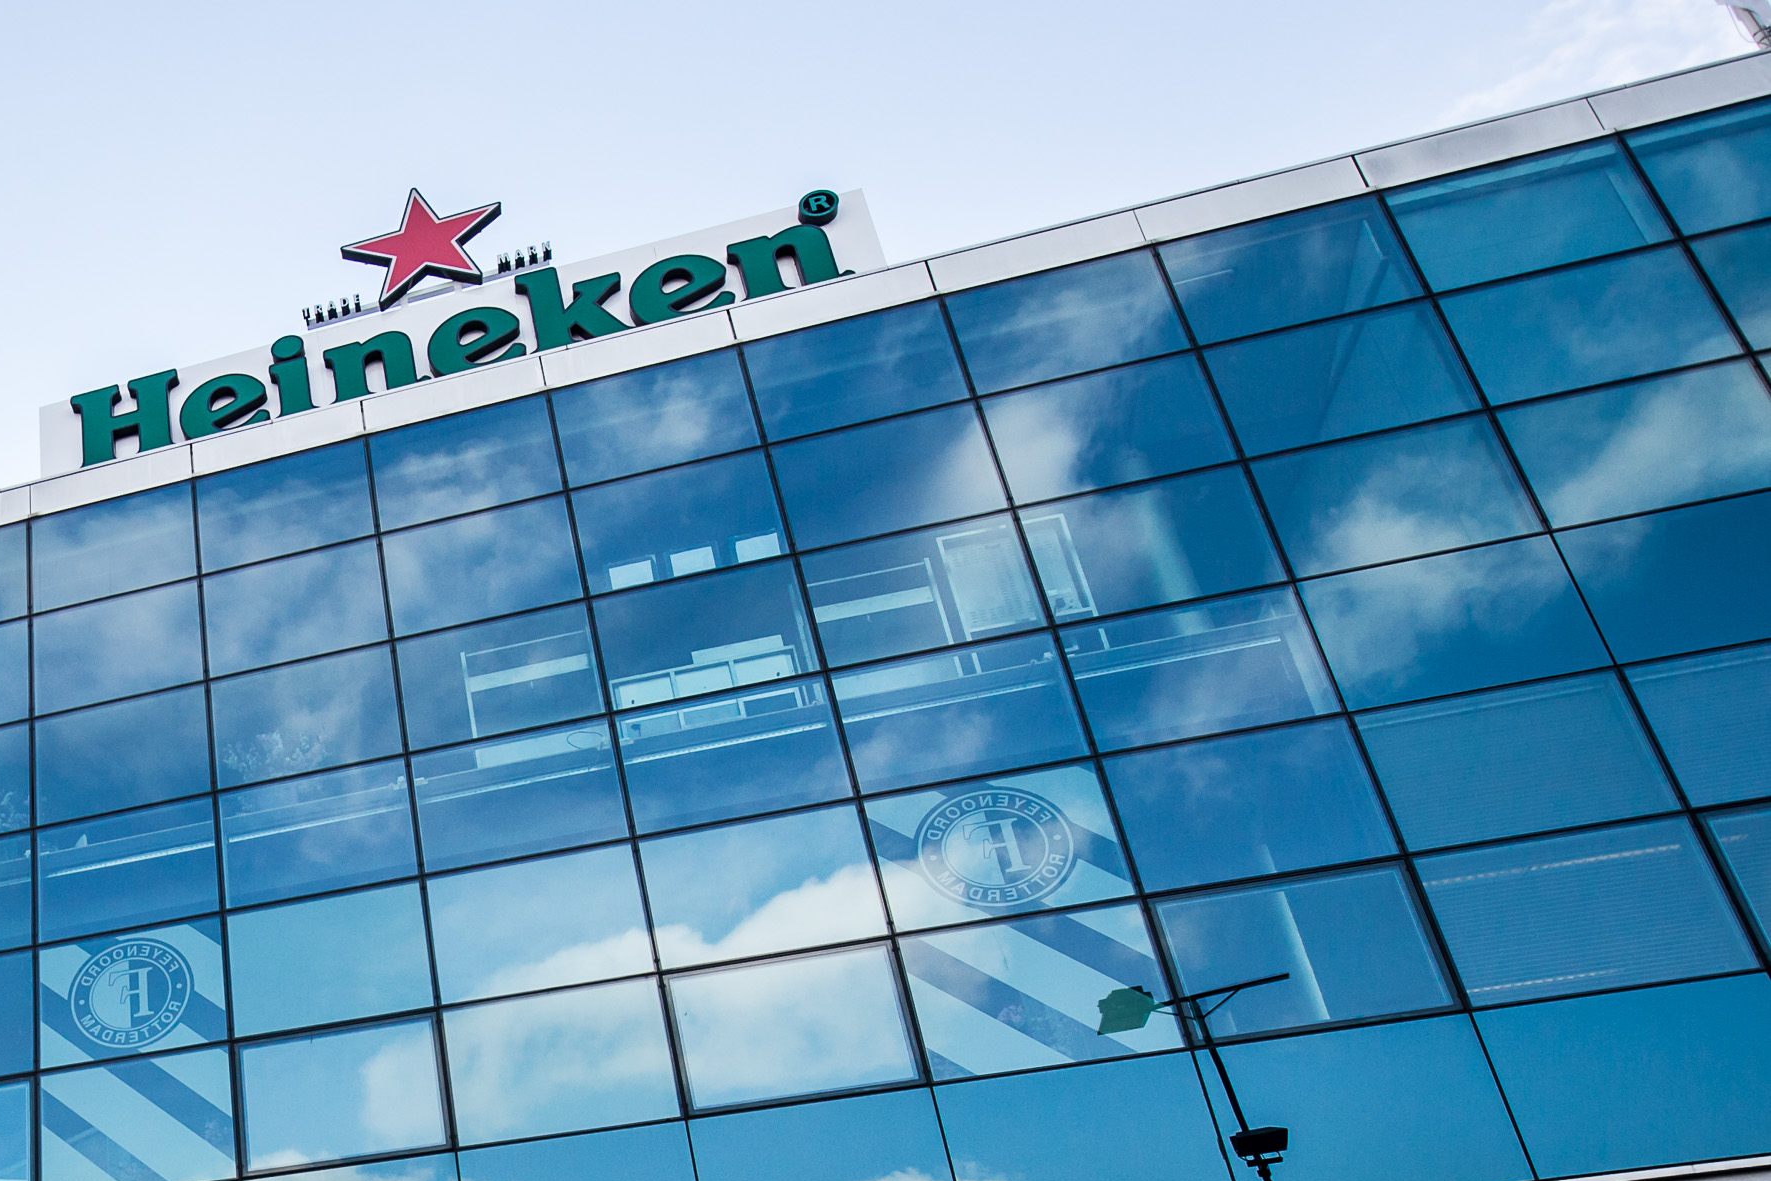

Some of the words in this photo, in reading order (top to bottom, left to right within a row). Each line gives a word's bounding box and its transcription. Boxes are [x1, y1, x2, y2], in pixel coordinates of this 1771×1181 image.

[496, 241, 553, 275] MARK
[301, 294, 362, 327] TRADE
[70, 224, 856, 469] Heineken
